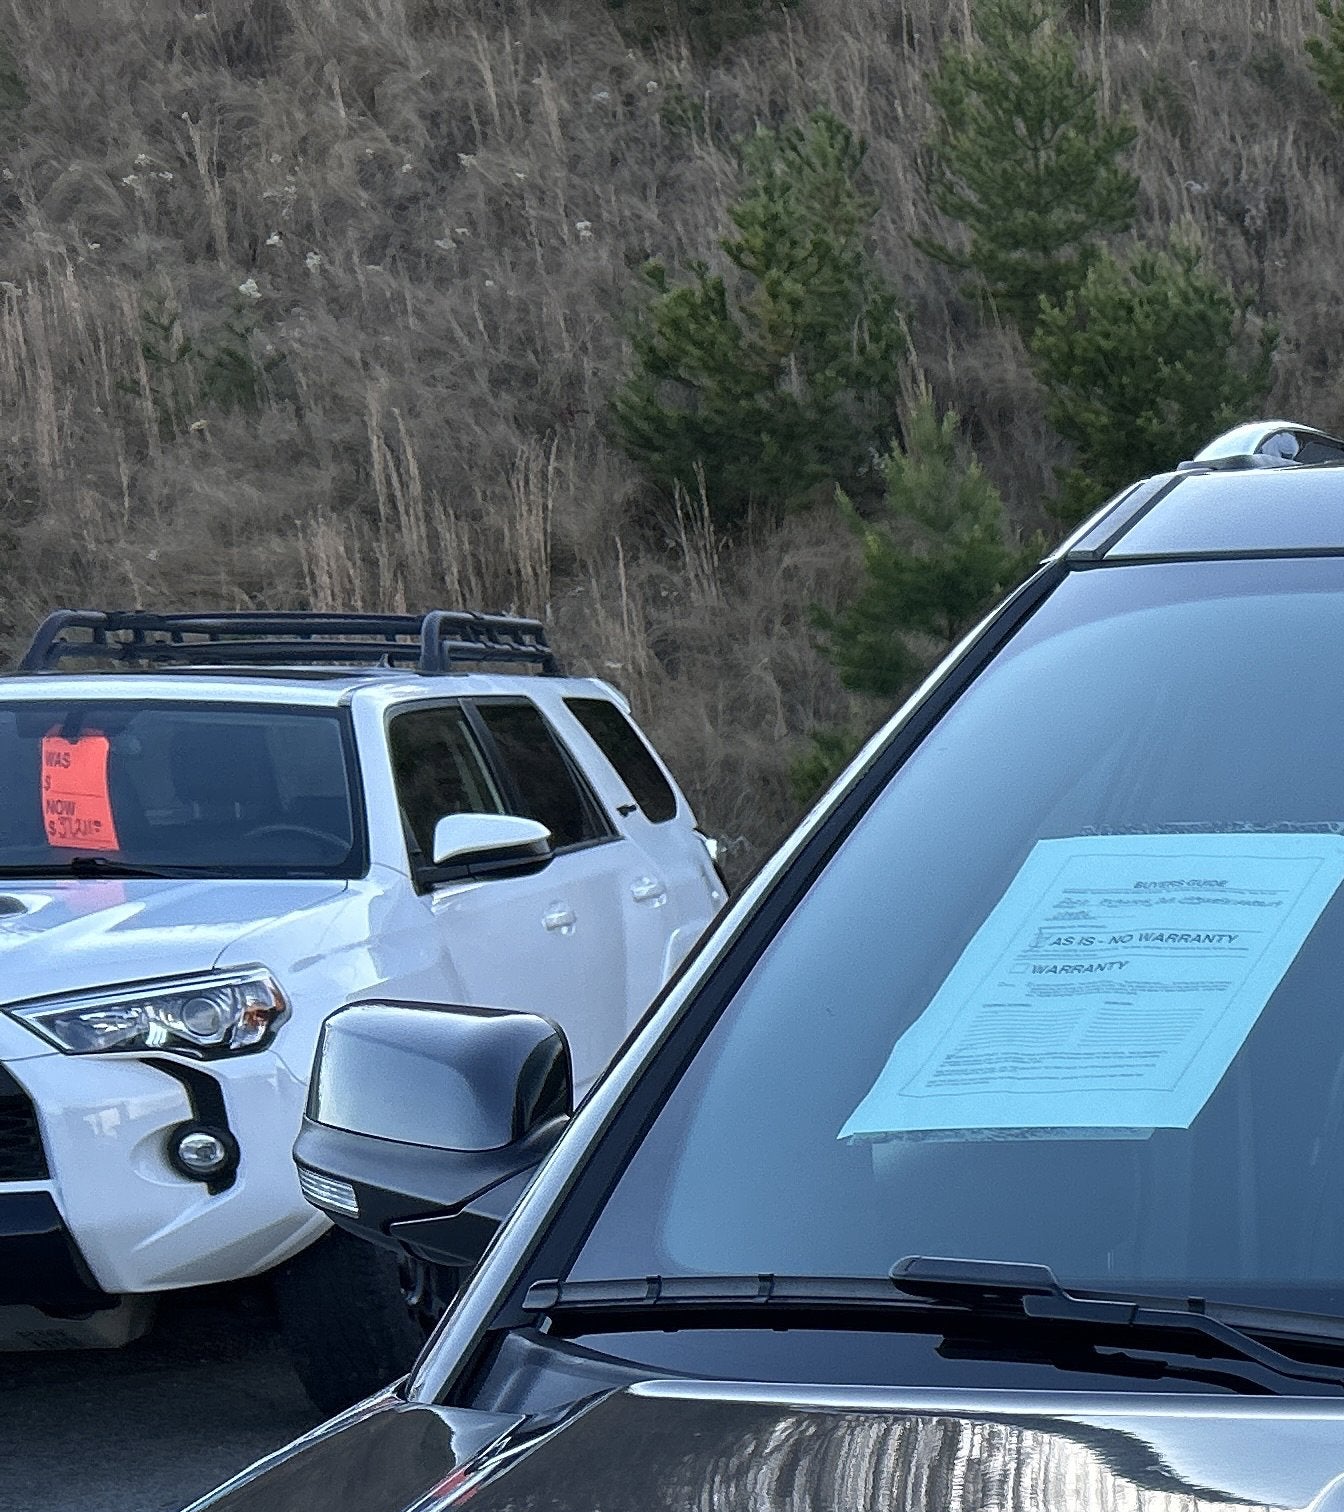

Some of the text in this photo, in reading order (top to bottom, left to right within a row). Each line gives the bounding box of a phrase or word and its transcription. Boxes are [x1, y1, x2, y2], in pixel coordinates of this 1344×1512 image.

[46, 752, 71, 768] WAS
[46, 800, 76, 815] NOW
[1134, 880, 1229, 889] BUYERS GUIDE
[1050, 936, 1074, 946] AS
[1078, 936, 1096, 946] IS
[1108, 934, 1135, 945] NO
[1138, 932, 1239, 945] WARRANTY
[1031, 960, 1130, 975] WARRANTY
